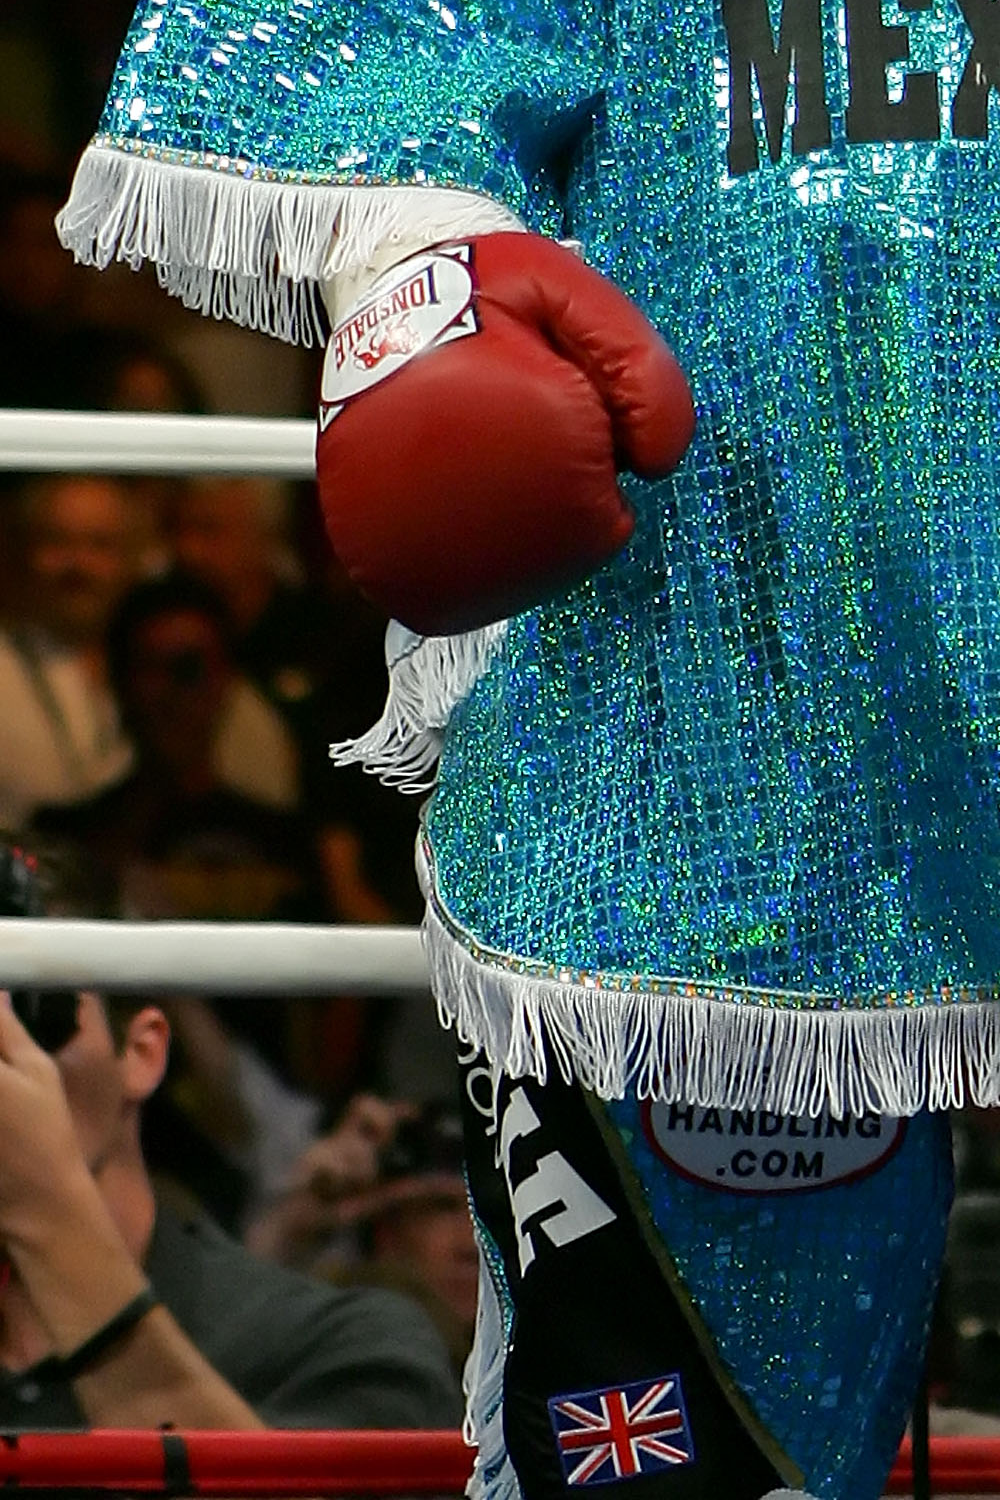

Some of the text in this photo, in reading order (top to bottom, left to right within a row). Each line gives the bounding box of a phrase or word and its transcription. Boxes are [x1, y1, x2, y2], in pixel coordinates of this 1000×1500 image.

[333, 261, 442, 372] LONSDALE
[667, 1101, 883, 1139] HANDLING
[714, 1149, 826, 1179] .COM
